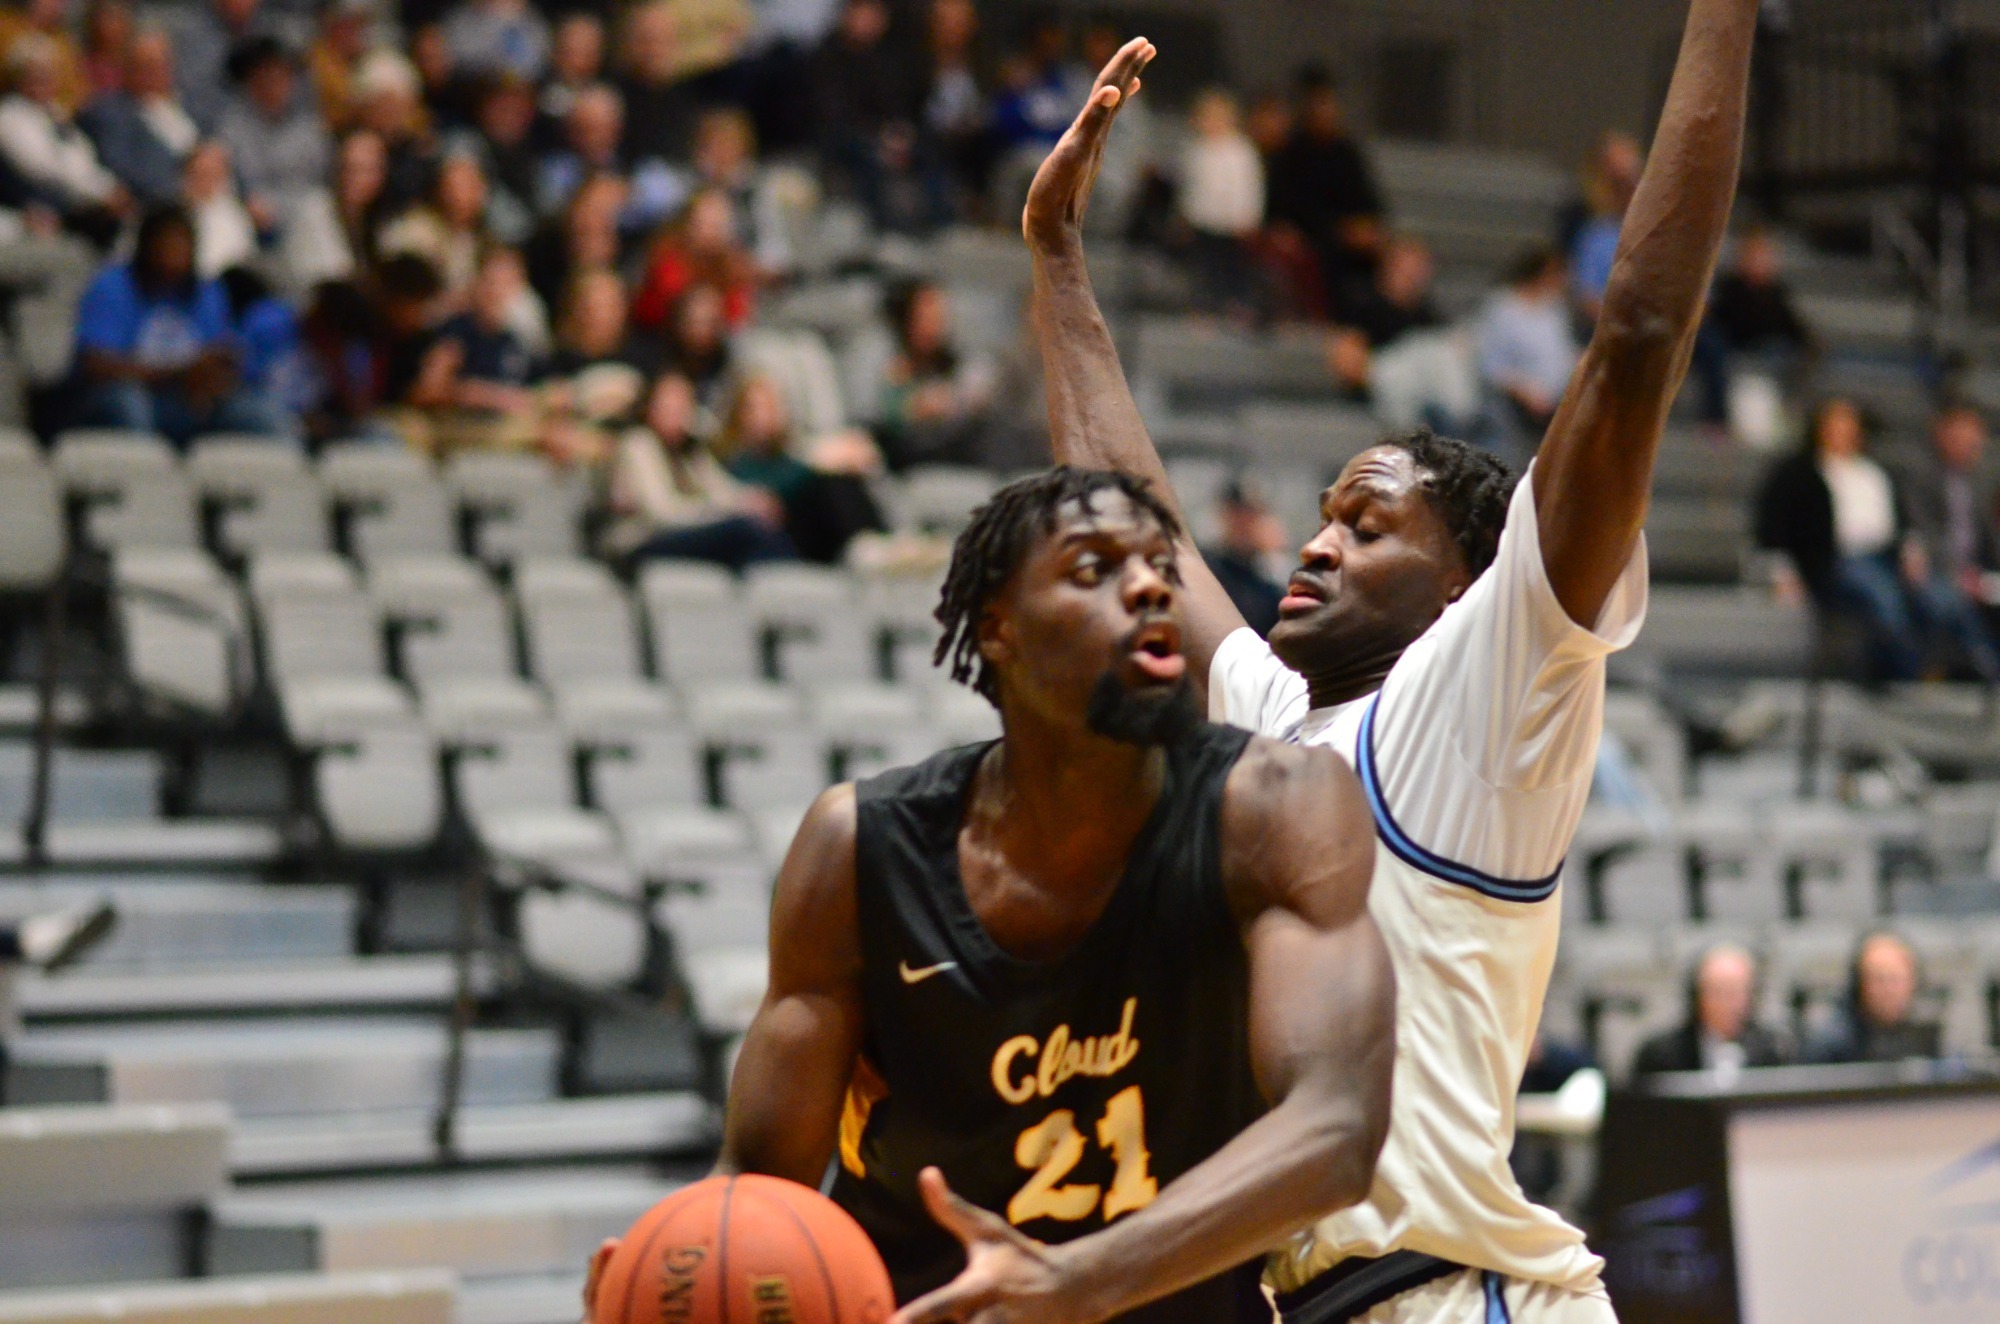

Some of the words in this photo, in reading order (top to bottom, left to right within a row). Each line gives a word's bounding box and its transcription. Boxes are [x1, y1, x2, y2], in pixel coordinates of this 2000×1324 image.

[991, 996, 1140, 1105] Cloud
[1007, 1085, 1158, 1225] 21
[659, 1246, 706, 1324] ING
